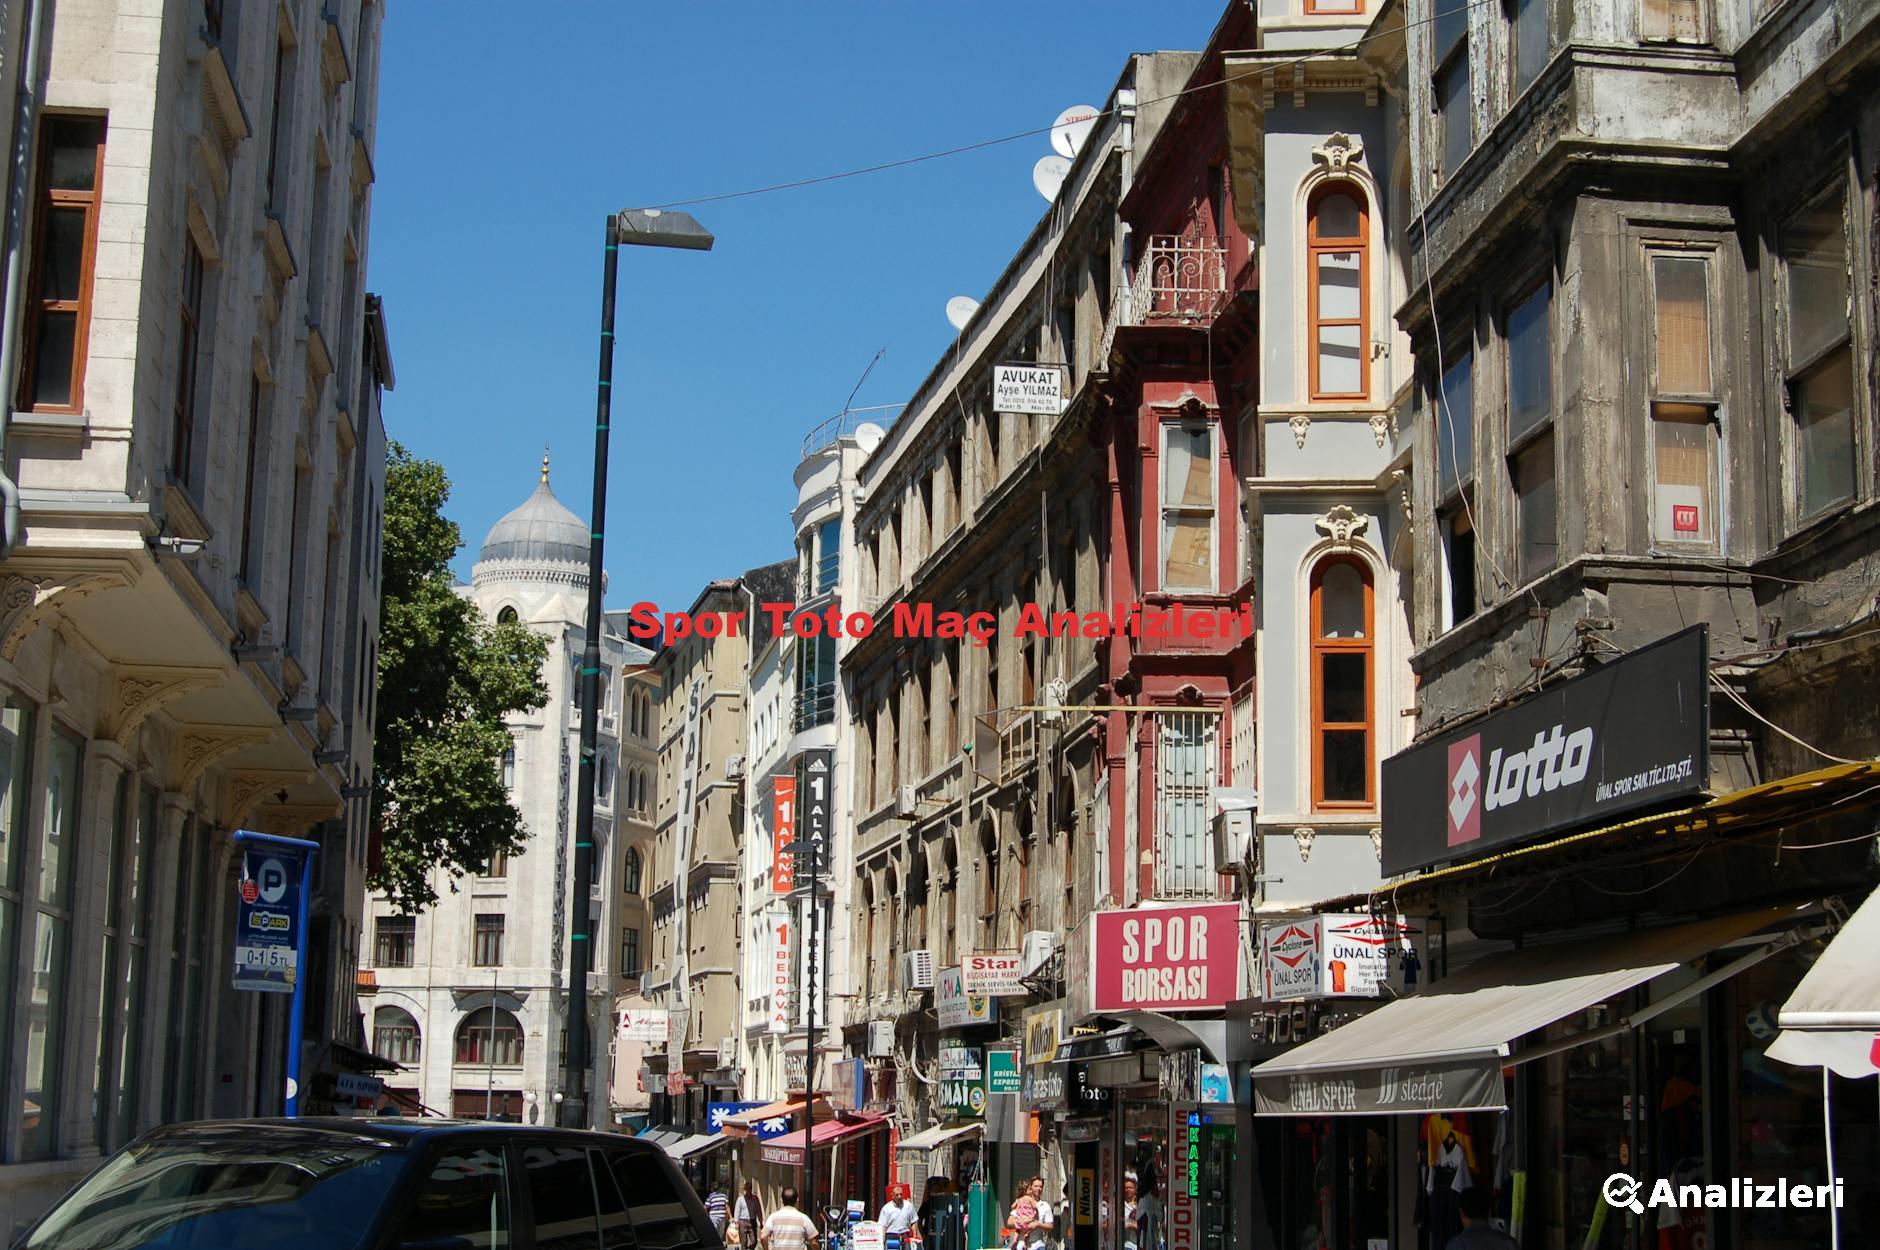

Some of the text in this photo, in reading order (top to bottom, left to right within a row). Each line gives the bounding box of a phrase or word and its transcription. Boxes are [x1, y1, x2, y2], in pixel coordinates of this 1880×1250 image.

[1001, 370, 1054, 384] AVUKAT
[997, 384, 1058, 397] Ayşe YILMAZ
[1485, 724, 1593, 812] lotto
[811, 777, 824, 801] 1
[1595, 781, 1613, 803] ÜNAL
[1613, 777, 1632, 797] SPOR
[778, 800, 790, 823] 1
[264, 869, 282, 892] P
[1122, 915, 1208, 964] SPOR
[1333, 944, 1418, 959] ÜNAL SPOR
[270, 952, 278, 966] 5
[972, 958, 1019, 969] Star
[775, 923, 788, 1022] 1 BEDAVA
[1122, 965, 1208, 1003] BORSASI
[1275, 968, 1312, 986] ÜNAL SPOR
[1029, 1019, 1054, 1056] Nikon
[1289, 1074, 1320, 1112] ÜNAL
[1322, 1079, 1357, 1111] SPOR
[1188, 1127, 1200, 1196] KAŞE
[1079, 1177, 1091, 1216] Nikon
